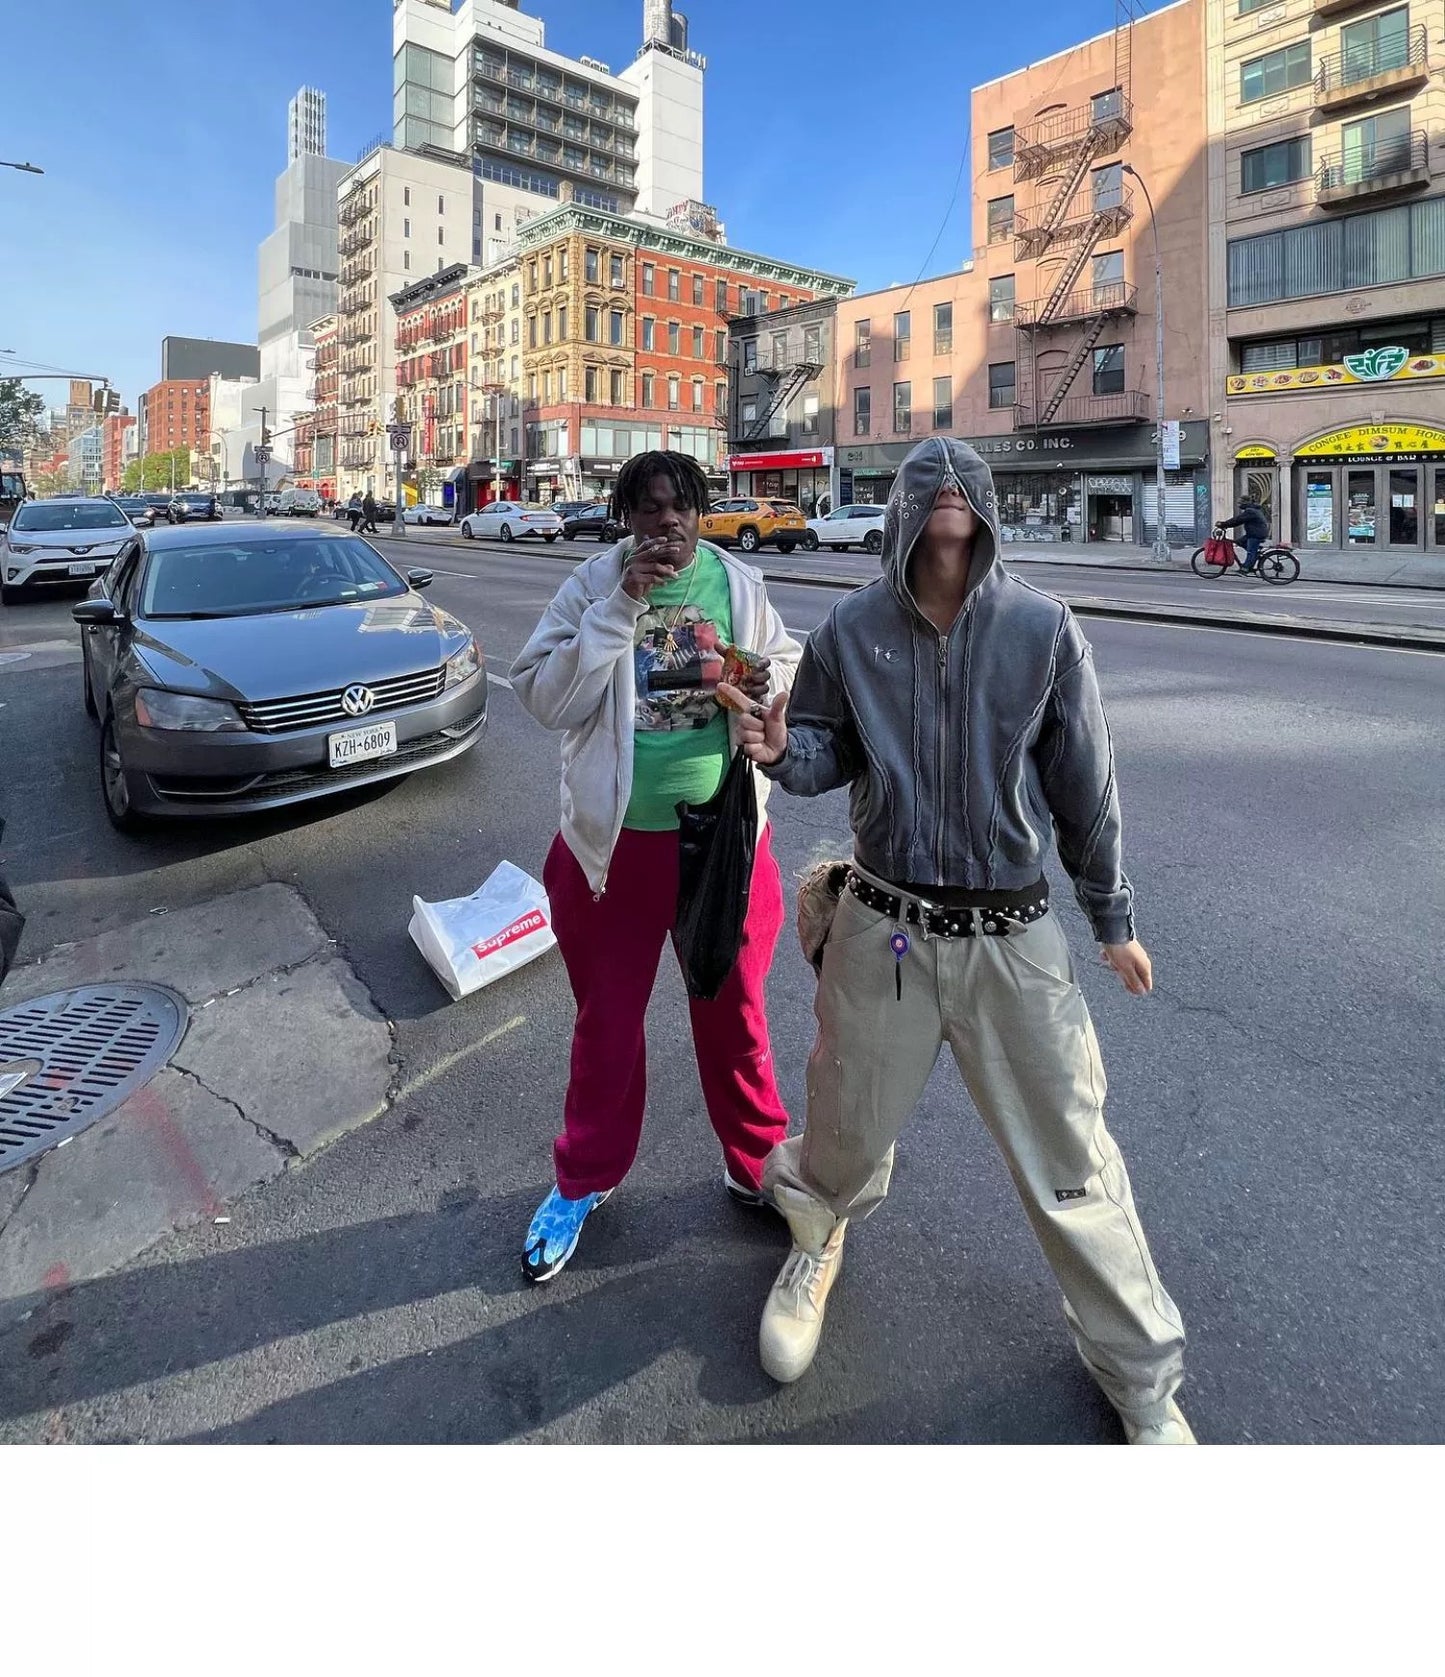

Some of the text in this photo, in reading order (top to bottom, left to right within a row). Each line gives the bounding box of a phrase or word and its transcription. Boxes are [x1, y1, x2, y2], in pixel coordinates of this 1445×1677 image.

[1016, 440, 1039, 451] CO.
[1044, 438, 1075, 449] INC.
[1309, 431, 1353, 452] CONGEE
[1358, 427, 1408, 435] DIMSUM
[1348, 455, 1383, 463] LOUNGE
[477, 914, 541, 952] Supreme
